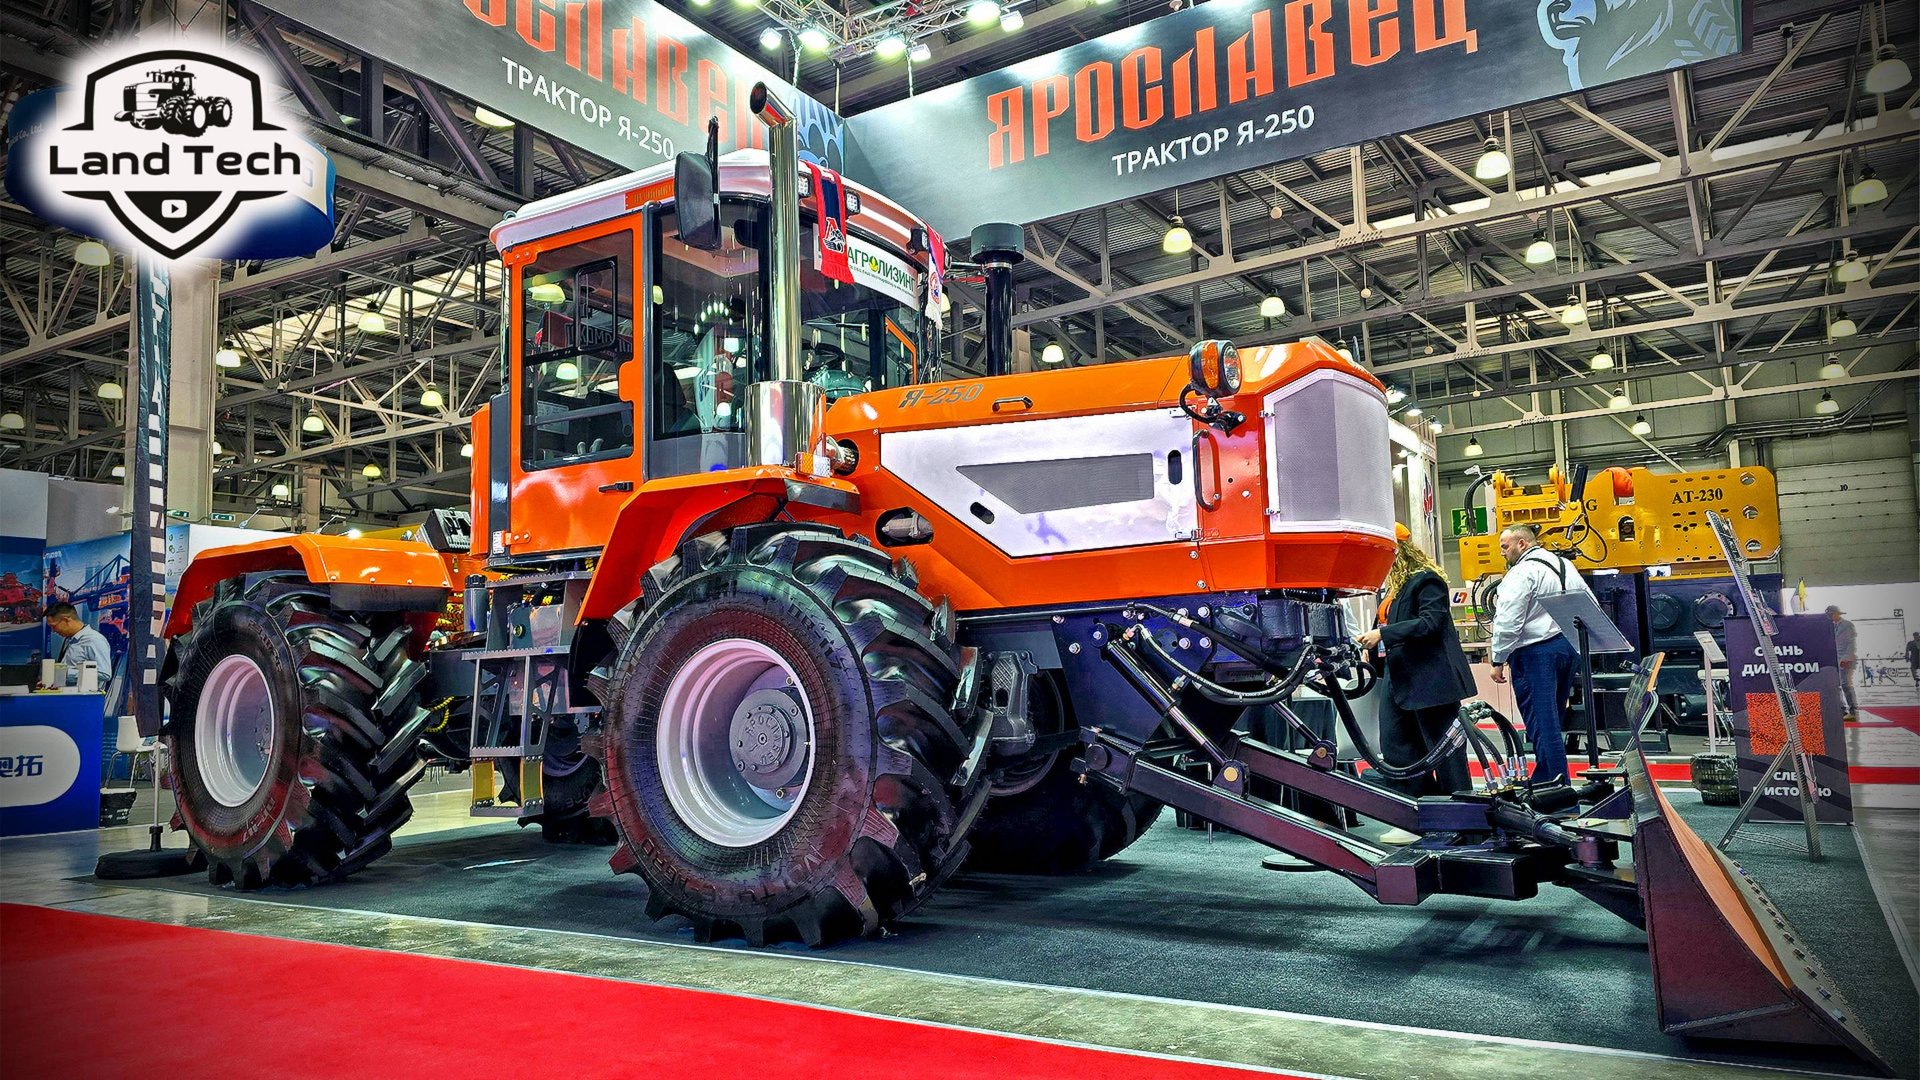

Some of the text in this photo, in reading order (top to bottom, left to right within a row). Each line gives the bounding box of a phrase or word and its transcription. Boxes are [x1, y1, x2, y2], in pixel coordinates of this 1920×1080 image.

[987, 0, 1478, 170] ЯРОСЛАВЕЦ
[501, 57, 675, 161] ТРАКТОР Я-250
[1112, 104, 1316, 176] ТРАКТОР Я-250
[898, 383, 985, 410] Я-250
[1671, 487, 1724, 505] AT-230
[1754, 645, 1804, 657] САНЬ
[1741, 662, 1820, 678] ДИЕРОМ
[1764, 786, 1832, 797] ИСТОЮ
